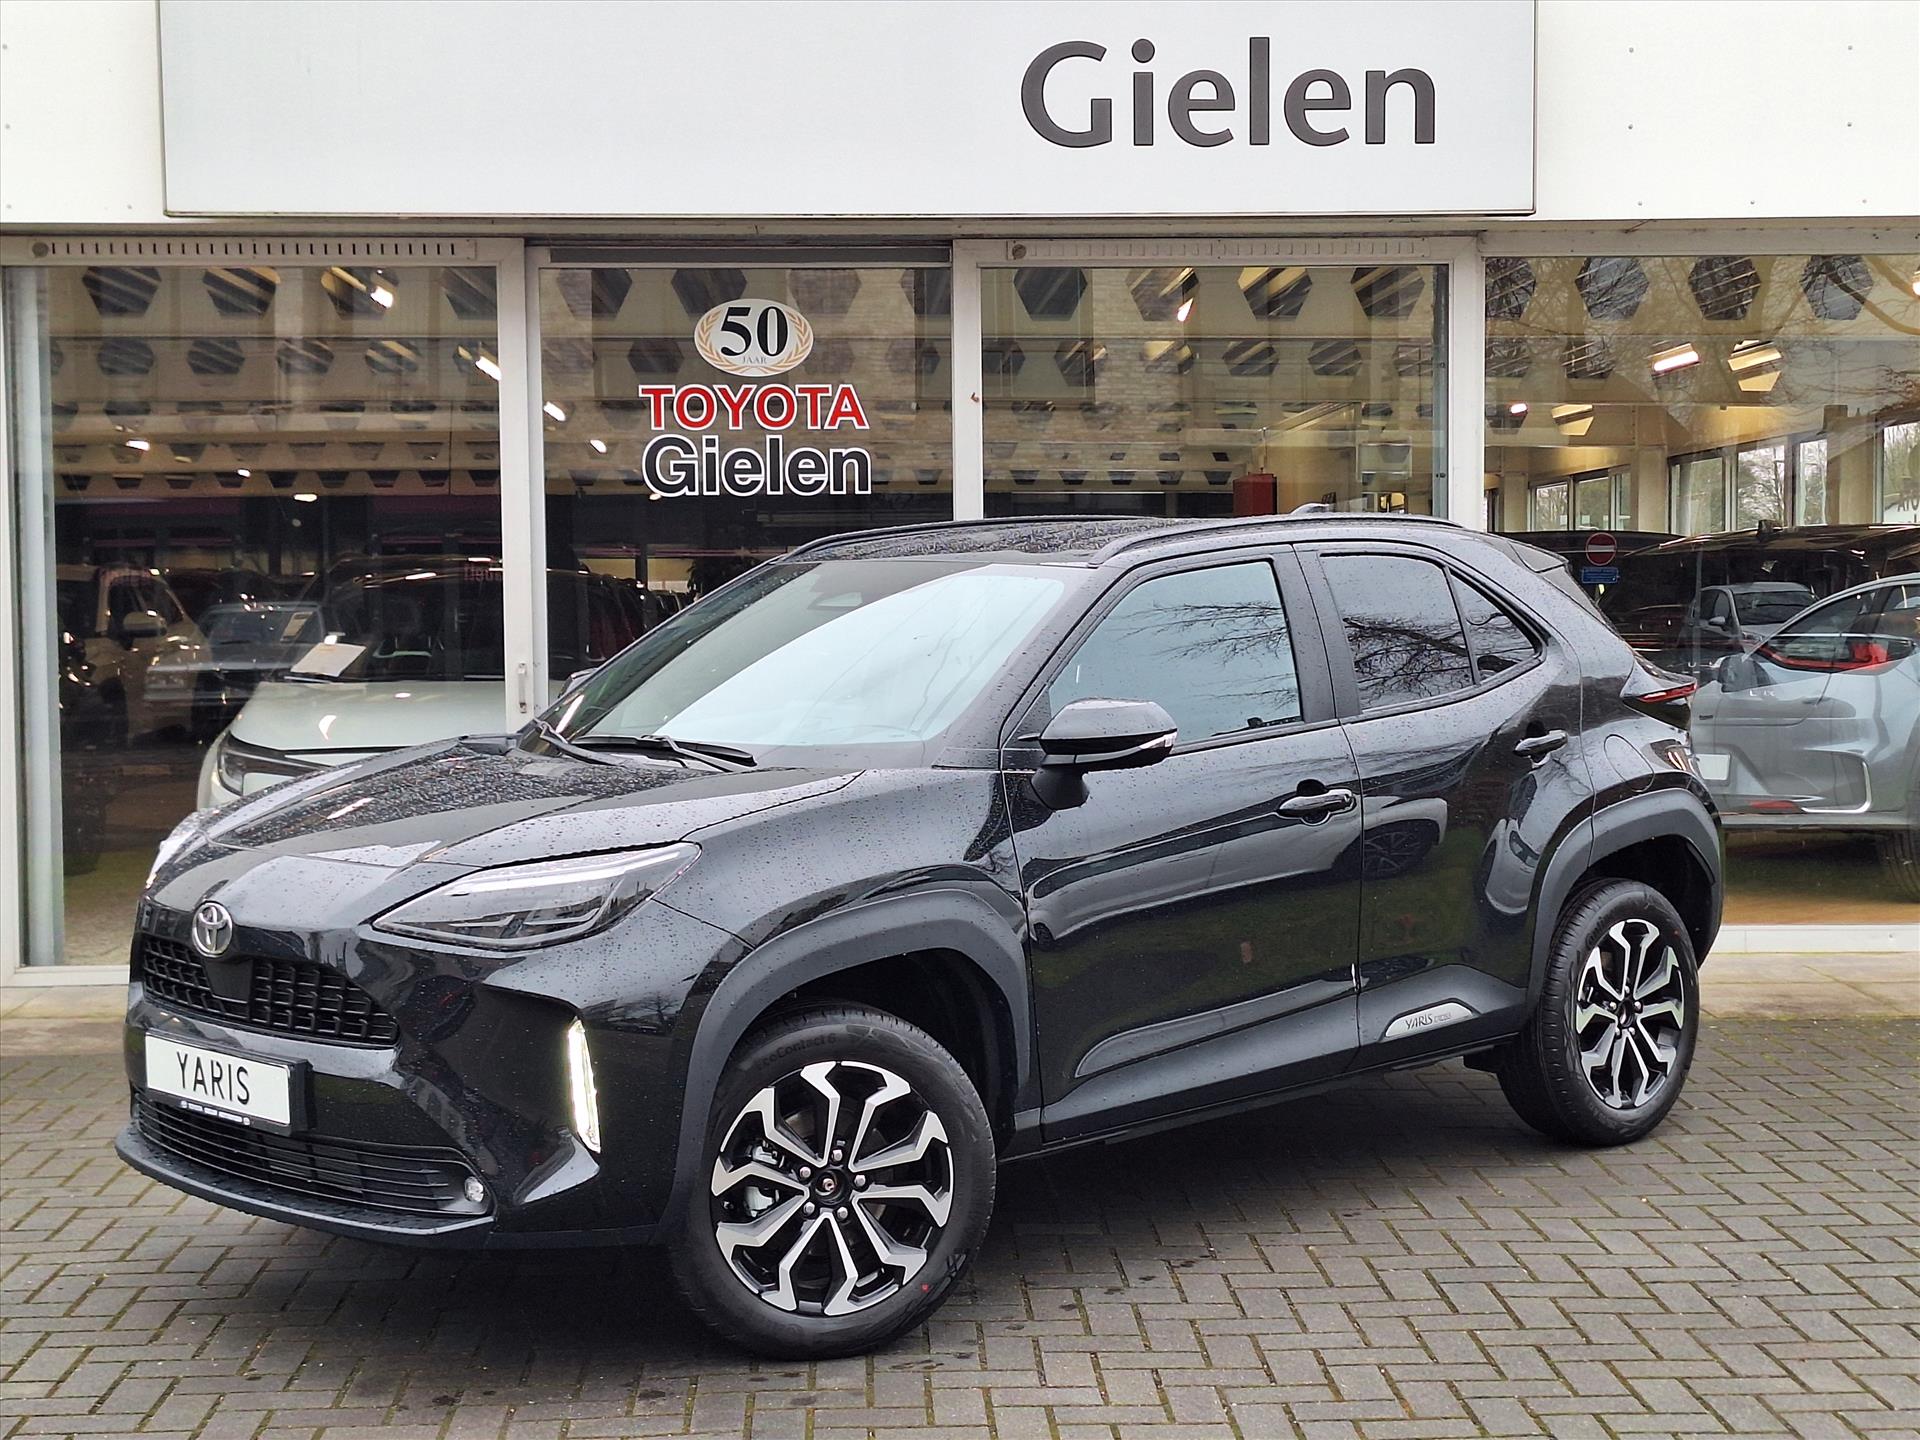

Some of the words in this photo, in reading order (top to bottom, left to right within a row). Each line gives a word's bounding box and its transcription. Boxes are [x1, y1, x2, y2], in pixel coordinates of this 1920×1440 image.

[1020, 36, 1437, 149] Gielen
[719, 305, 789, 357] 50
[741, 355, 768, 365] JAAR
[638, 383, 870, 431] TOYOTA
[641, 433, 872, 497] Gielen
[1405, 1013, 1433, 1030] YARIS
[176, 1051, 250, 1105] YARIS
